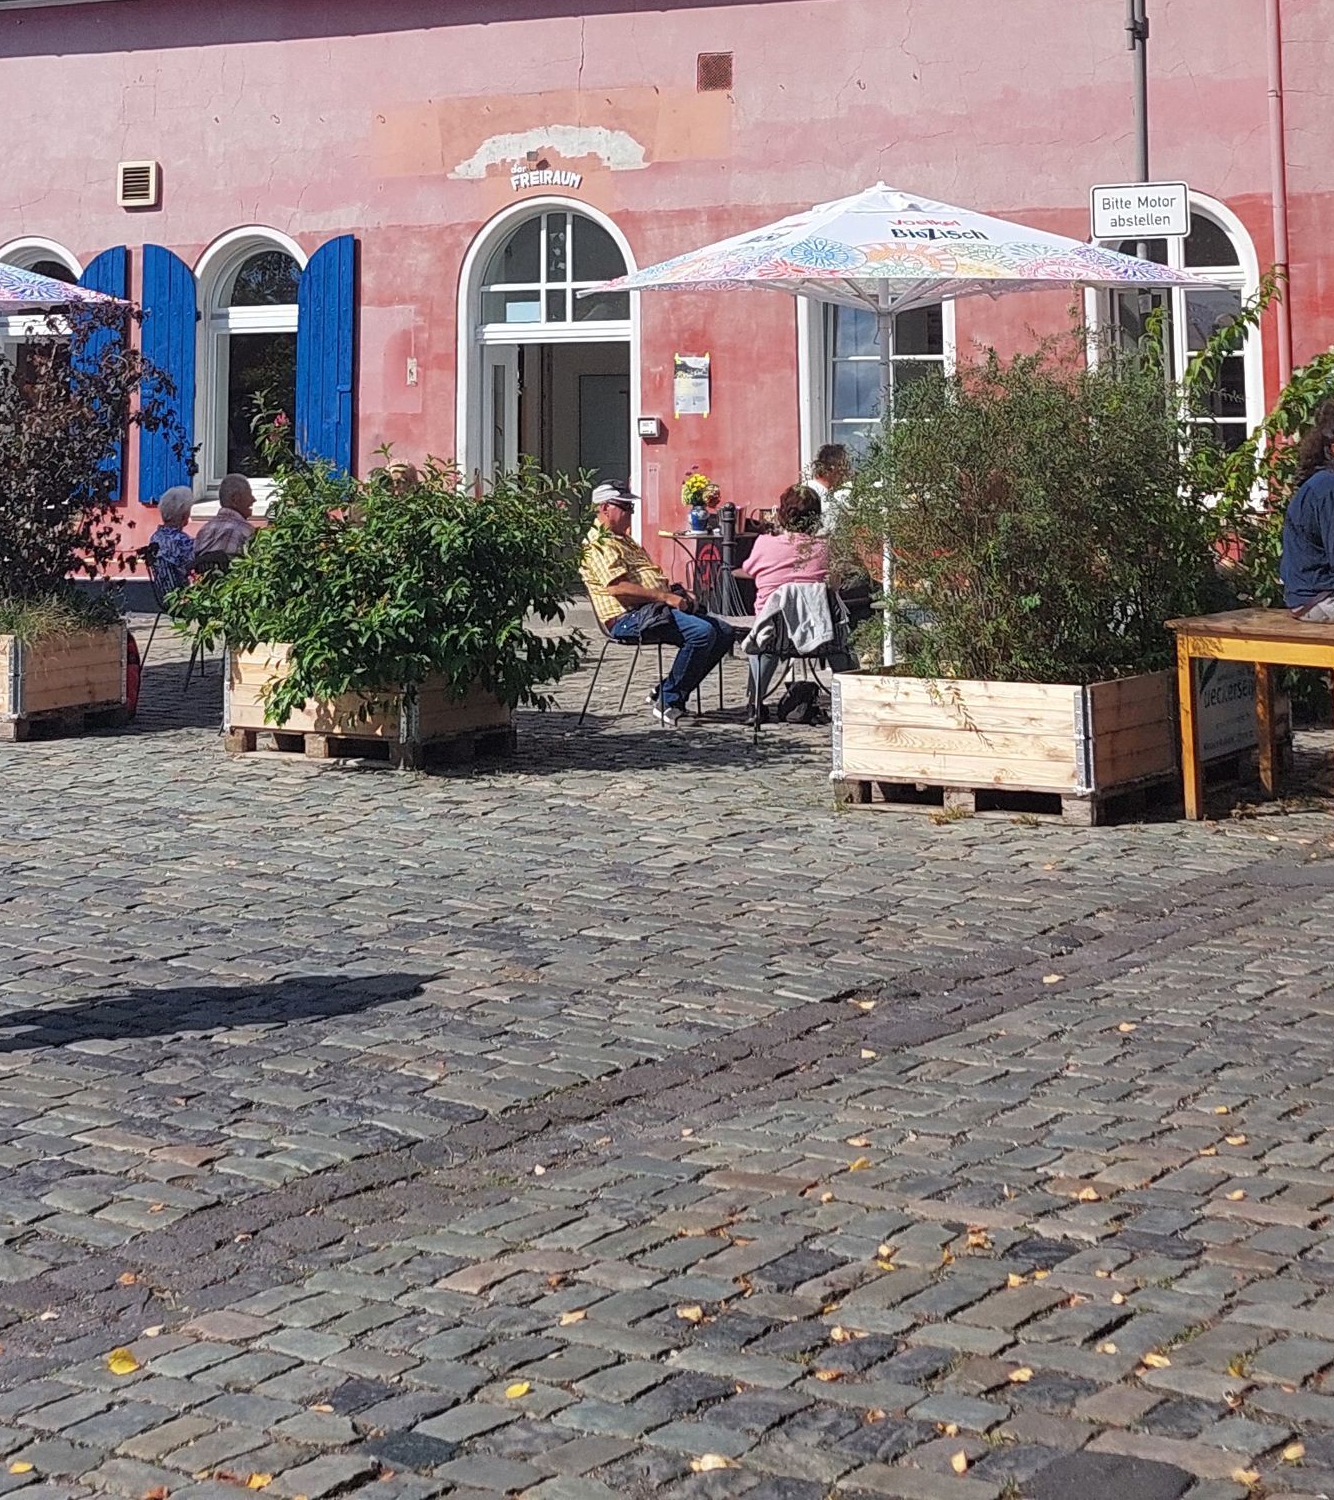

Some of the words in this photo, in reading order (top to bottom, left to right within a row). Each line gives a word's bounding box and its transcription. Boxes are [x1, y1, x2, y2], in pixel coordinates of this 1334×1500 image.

[509, 169, 583, 191] FREIRAUM
[1102, 196, 1132, 210] Bitte
[1137, 195, 1177, 209] Motor
[1110, 212, 1171, 227] abstellen
